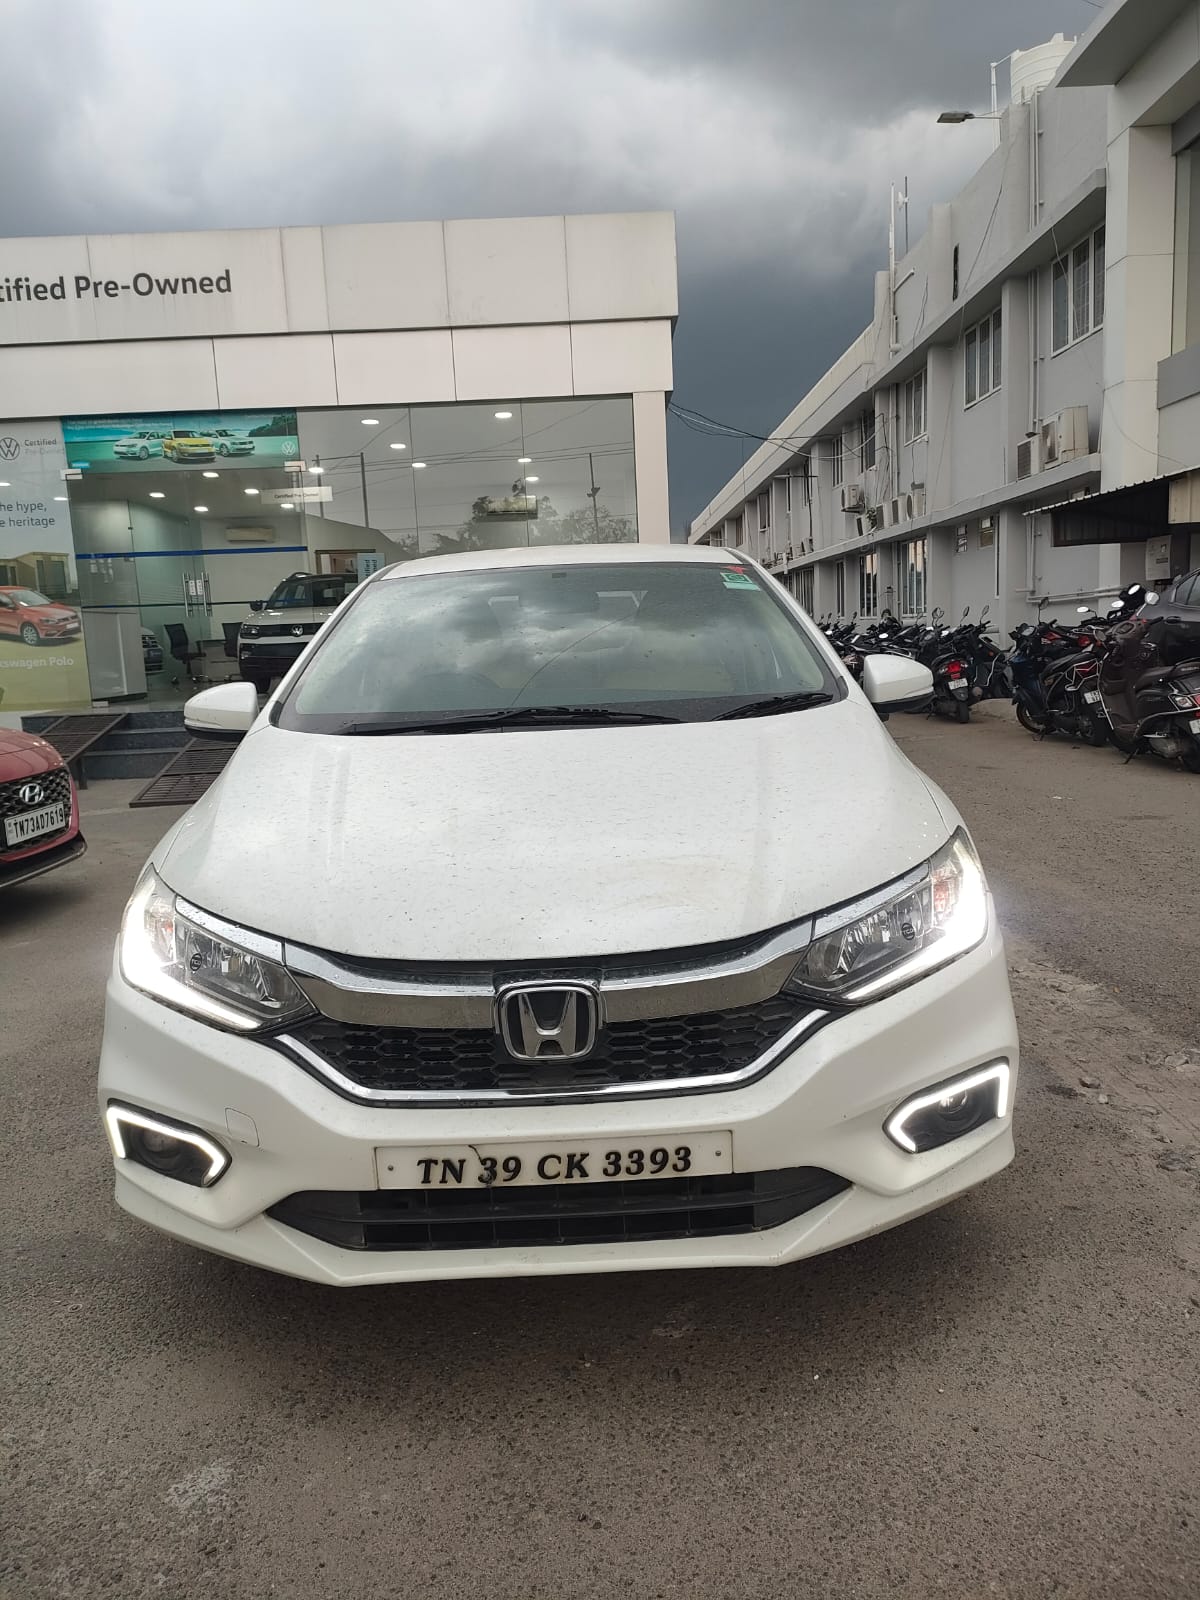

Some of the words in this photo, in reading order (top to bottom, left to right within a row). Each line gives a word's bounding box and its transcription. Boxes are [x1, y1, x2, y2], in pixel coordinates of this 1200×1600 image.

[74, 269, 232, 299] Pre-Owned
[24, 438, 57, 446] Certified
[16, 501, 47, 513] hype,
[9, 516, 55, 528] heritage
[48, 656, 74, 666] Polo
[13, 807, 64, 839] TN73AD7619
[417, 1158, 466, 1184] TN
[478, 1156, 522, 1184] 39
[537, 1152, 590, 1180] CK
[602, 1146, 692, 1177] 3393
